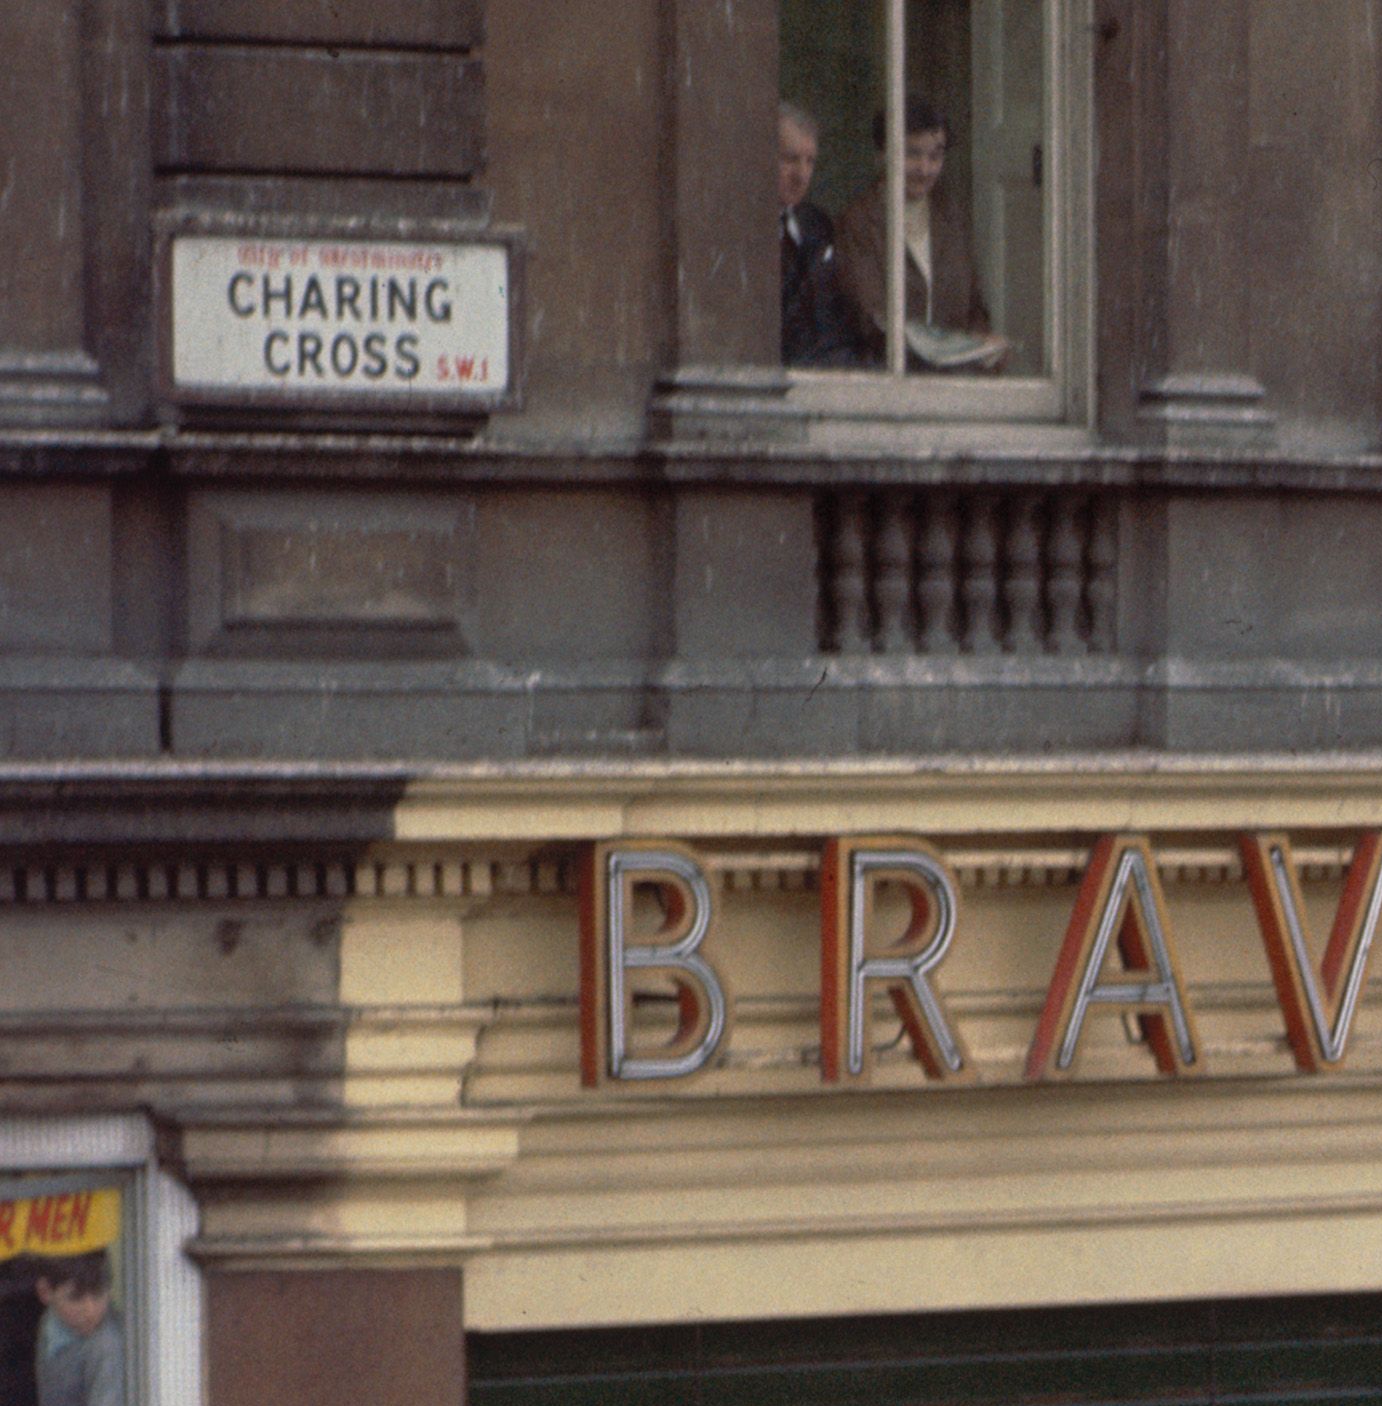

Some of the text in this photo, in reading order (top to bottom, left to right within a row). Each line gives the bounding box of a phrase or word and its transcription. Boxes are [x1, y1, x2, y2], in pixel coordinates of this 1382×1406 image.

[228, 272, 453, 323] CHARING
[263, 329, 421, 379] CROSS
[24, 1191, 94, 1246] MEN
